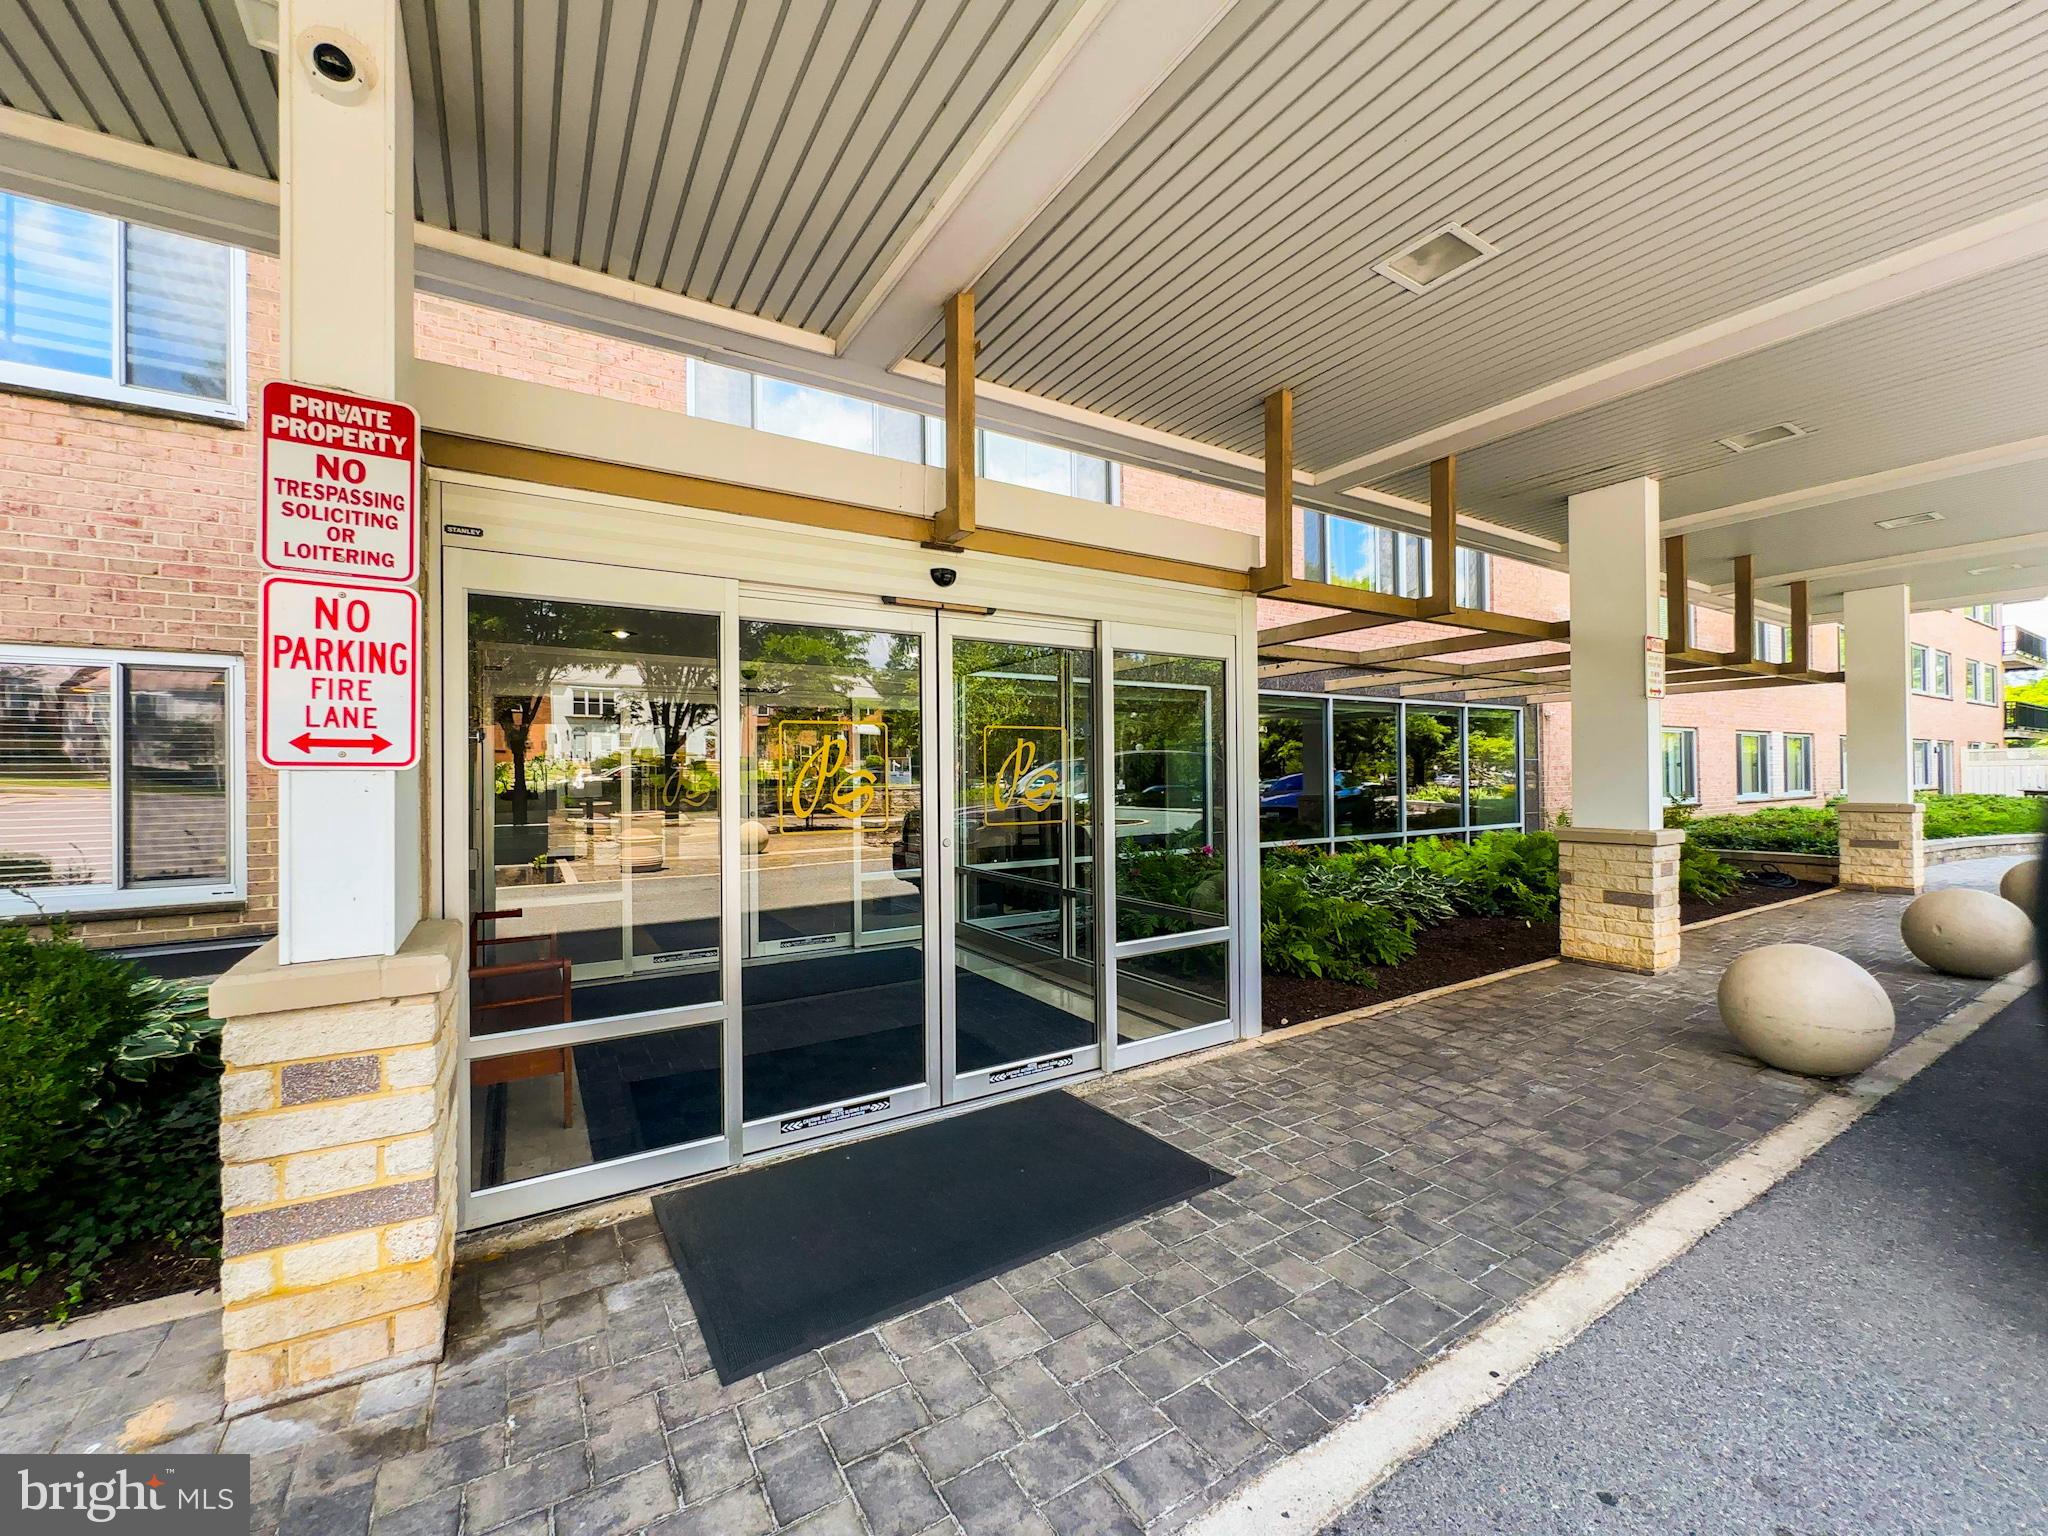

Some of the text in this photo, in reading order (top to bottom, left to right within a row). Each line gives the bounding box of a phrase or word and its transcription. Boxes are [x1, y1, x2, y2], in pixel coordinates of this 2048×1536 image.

[290, 394, 391, 431] PRIVATE
[271, 414, 408, 455] PROPERTY
[316, 454, 366, 484] NO
[274, 478, 405, 512] TRESPASSING
[281, 501, 399, 530] SOLICITING
[327, 526, 355, 544] OR
[447, 527, 481, 535] STANLEY
[283, 541, 395, 567] LOITERING
[315, 597, 370, 633] NO
[273, 635, 408, 676] PARKING
[311, 677, 372, 701] FIRE
[305, 705, 378, 729] LANE
